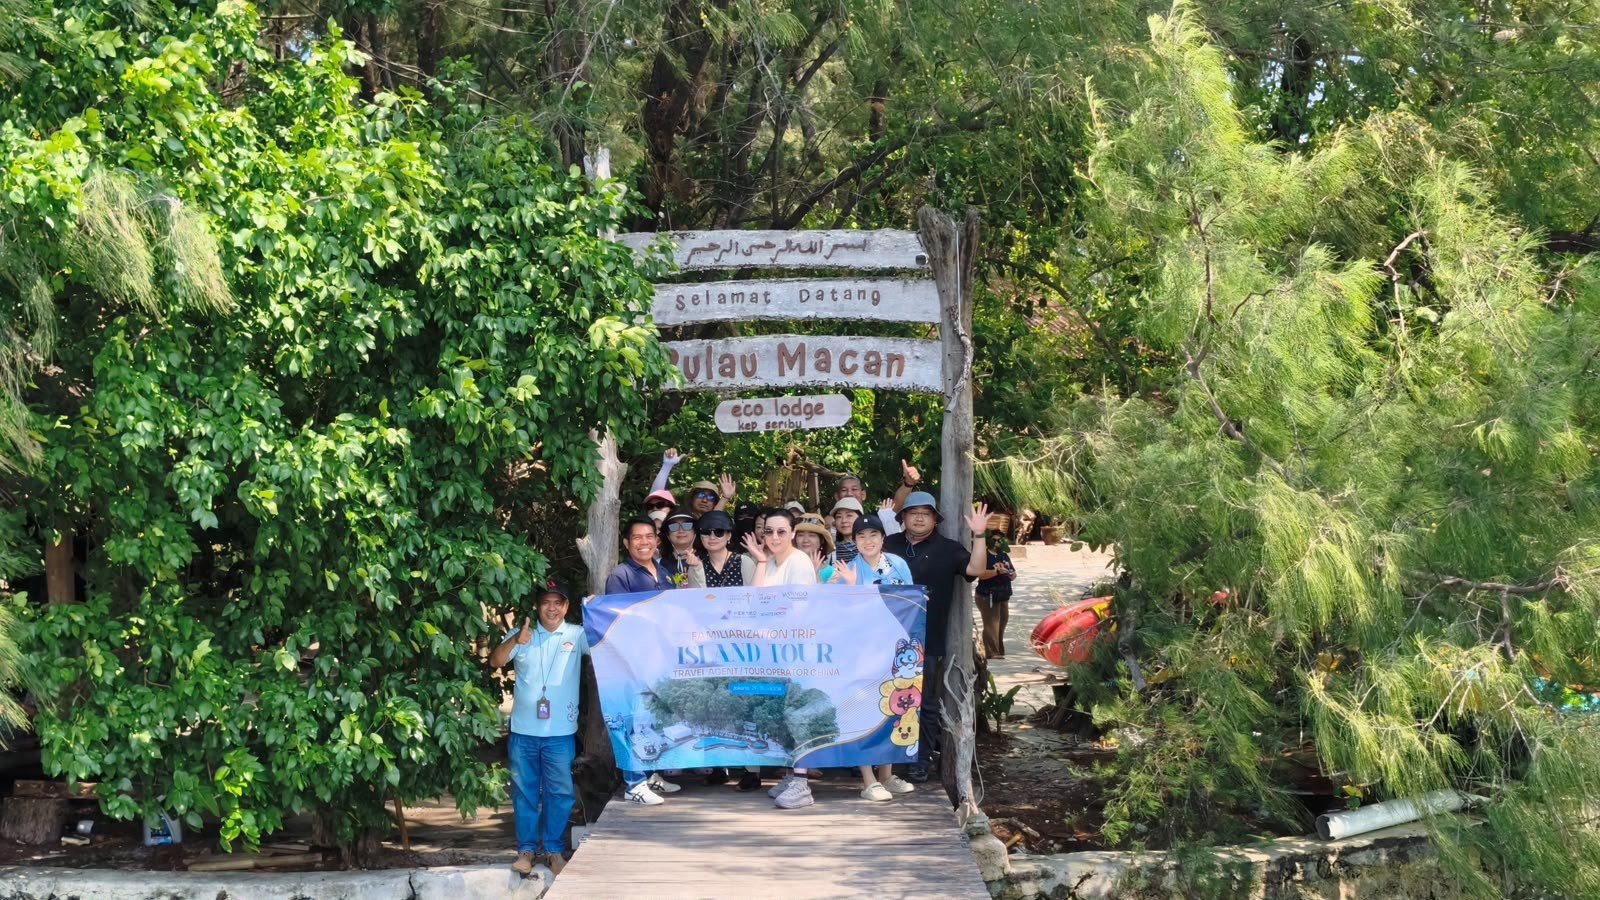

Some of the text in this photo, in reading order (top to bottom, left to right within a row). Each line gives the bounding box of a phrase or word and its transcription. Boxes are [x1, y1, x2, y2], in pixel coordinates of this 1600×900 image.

[676, 288, 881, 311] Selamat Datang
[777, 342, 905, 378] Macan
[731, 398, 825, 420] eco lodge
[738, 418, 802, 431] kep seribu
[691, 628, 817, 641] FAMILIARIZATION TRIP
[677, 643, 833, 665] ISLAND TOUR
[673, 668, 705, 678] TRAVEL
[708, 667, 739, 676] AGENT
[745, 667, 765, 676] TOUR
[766, 668, 809, 677] OPERATOR
[810, 668, 840, 677] CHINA
